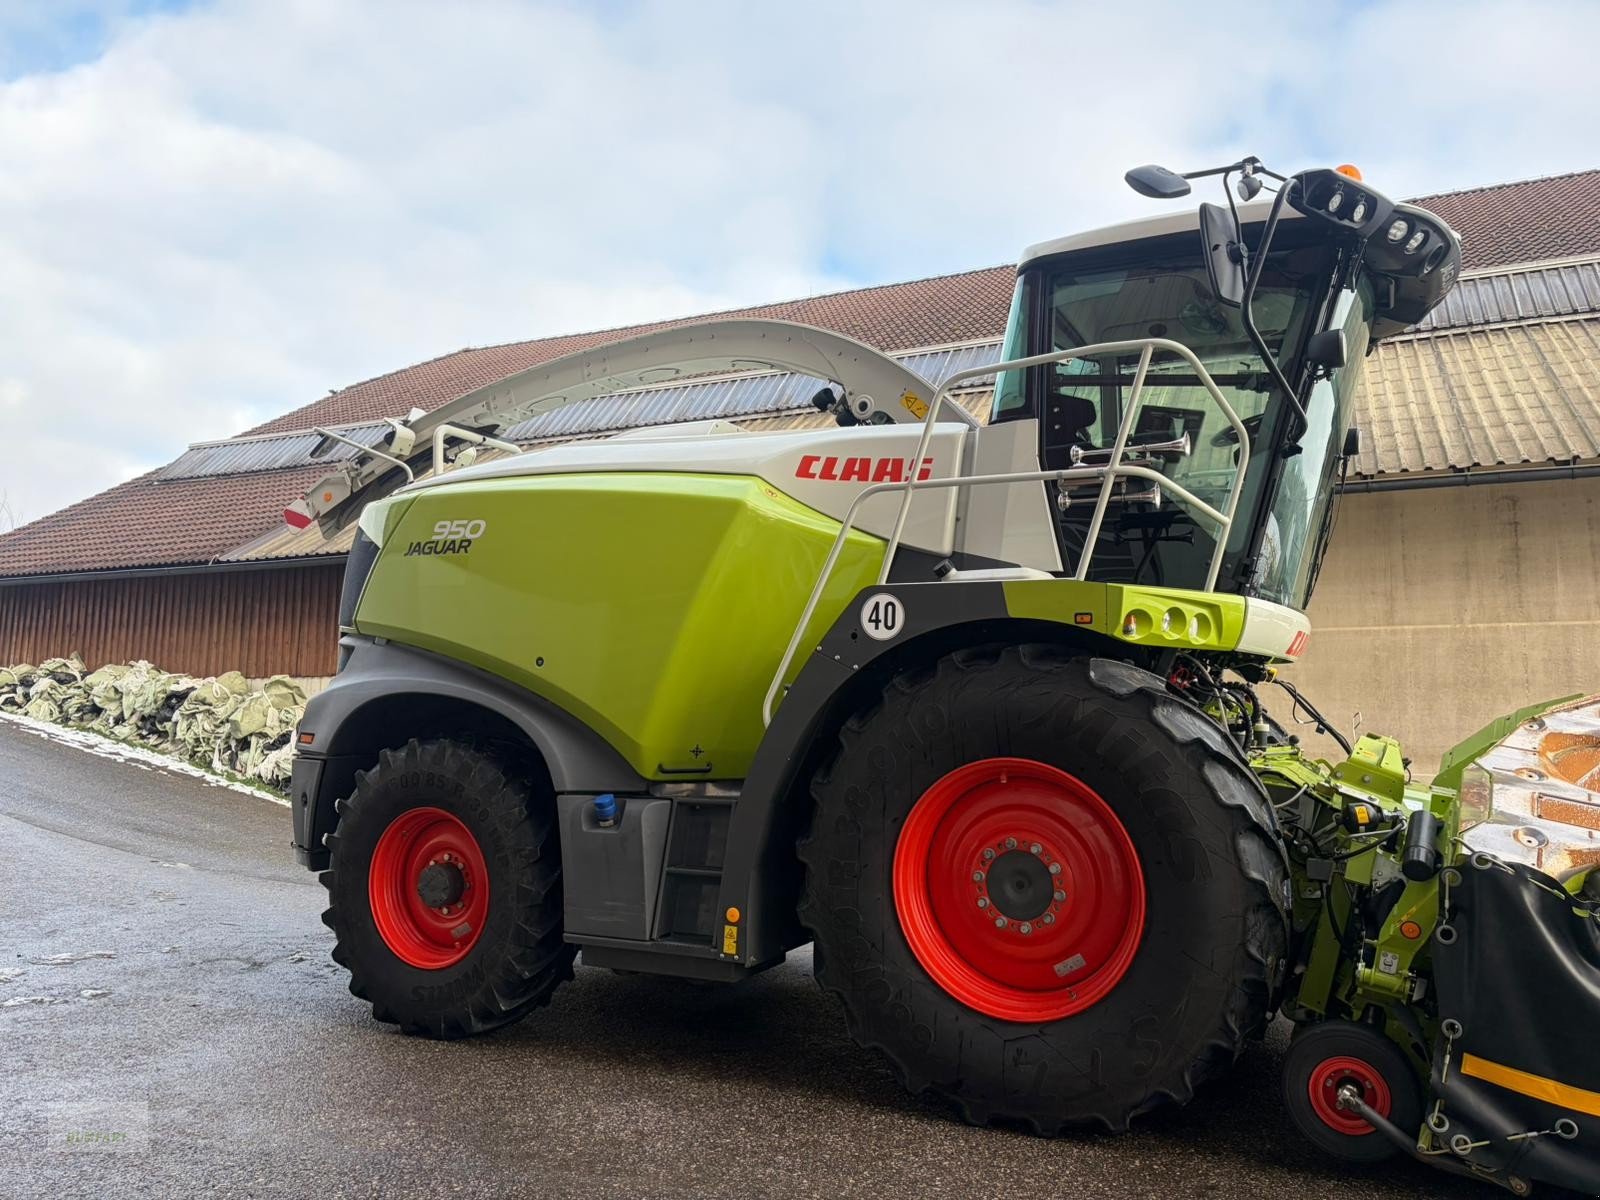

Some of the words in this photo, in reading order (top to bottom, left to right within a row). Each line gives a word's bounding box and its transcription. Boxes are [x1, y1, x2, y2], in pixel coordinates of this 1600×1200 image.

[795, 455, 934, 483] CLAAS
[432, 519, 487, 540] 950
[404, 539, 472, 557] JAGUAR
[868, 601, 896, 631] 40
